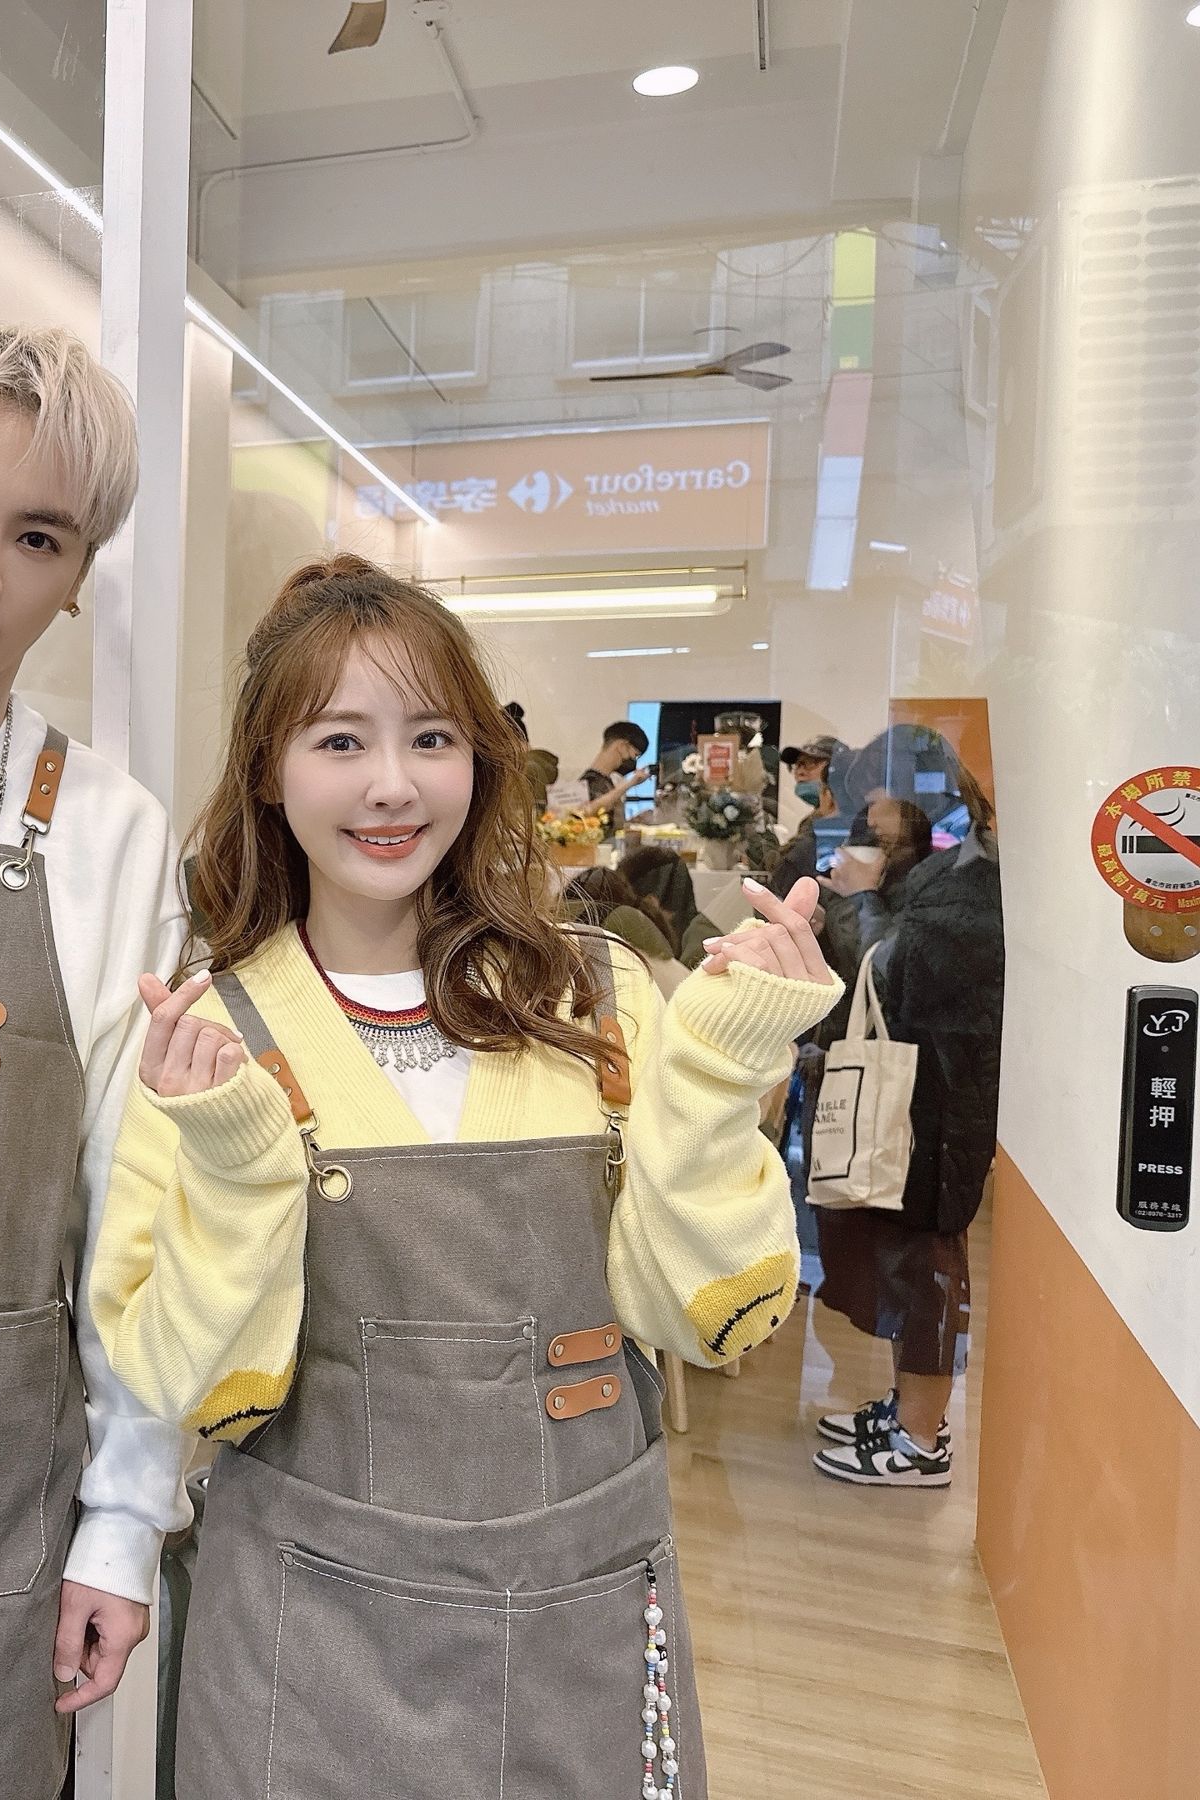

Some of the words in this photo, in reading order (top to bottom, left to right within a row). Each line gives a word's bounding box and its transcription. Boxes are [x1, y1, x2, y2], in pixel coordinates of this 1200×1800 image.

[1105, 770, 1200, 819] 本場所禁
[1149, 1077, 1177, 1128] 輕押
[1138, 1163, 1184, 1175] PRESS
